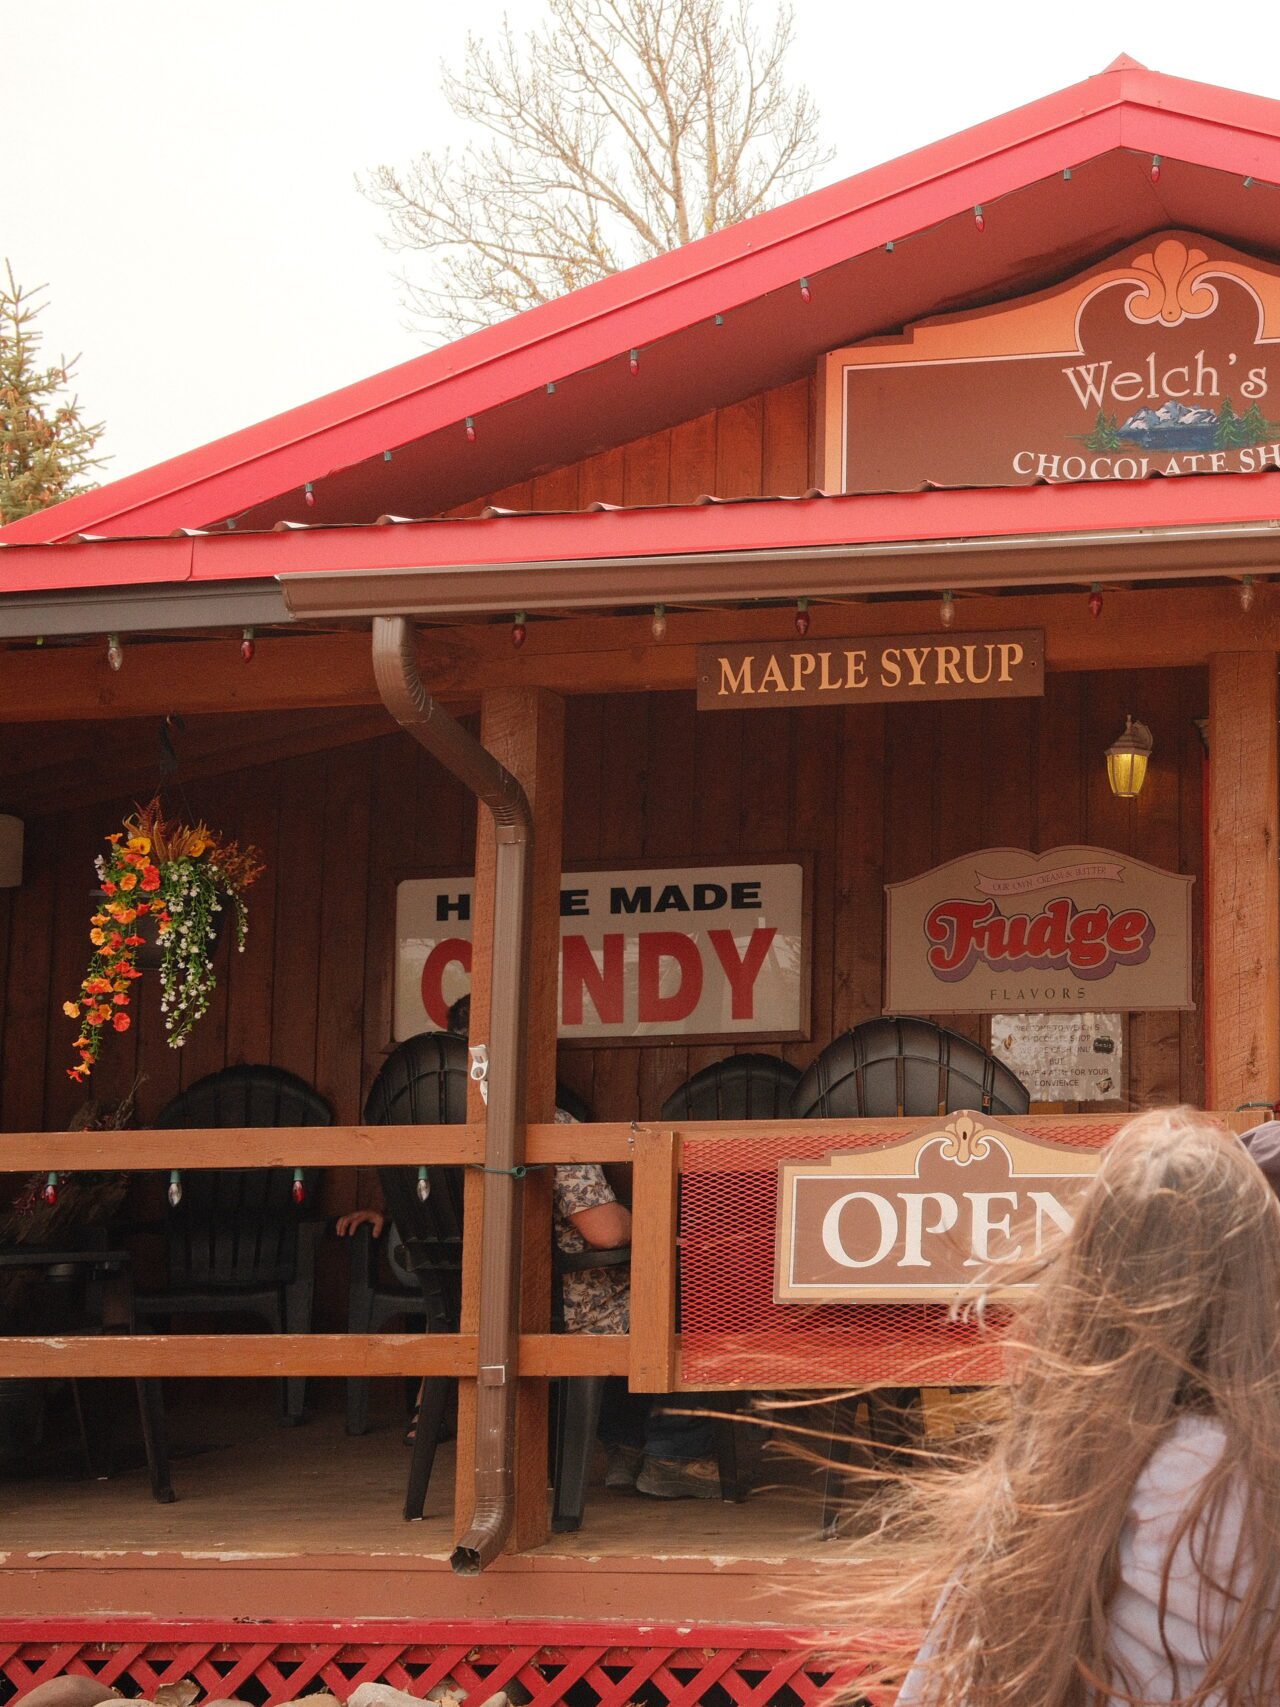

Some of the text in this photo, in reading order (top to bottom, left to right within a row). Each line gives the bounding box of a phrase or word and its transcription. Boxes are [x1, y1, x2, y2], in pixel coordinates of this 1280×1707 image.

[1061, 350, 1268, 411] Welch's
[717, 643, 1024, 695] MAPLE SYRUP
[436, 881, 762, 922] HE MADE
[924, 897, 1152, 976] Fudge
[421, 926, 778, 1030] CNDY
[990, 987, 1087, 1001] FLAVORS
